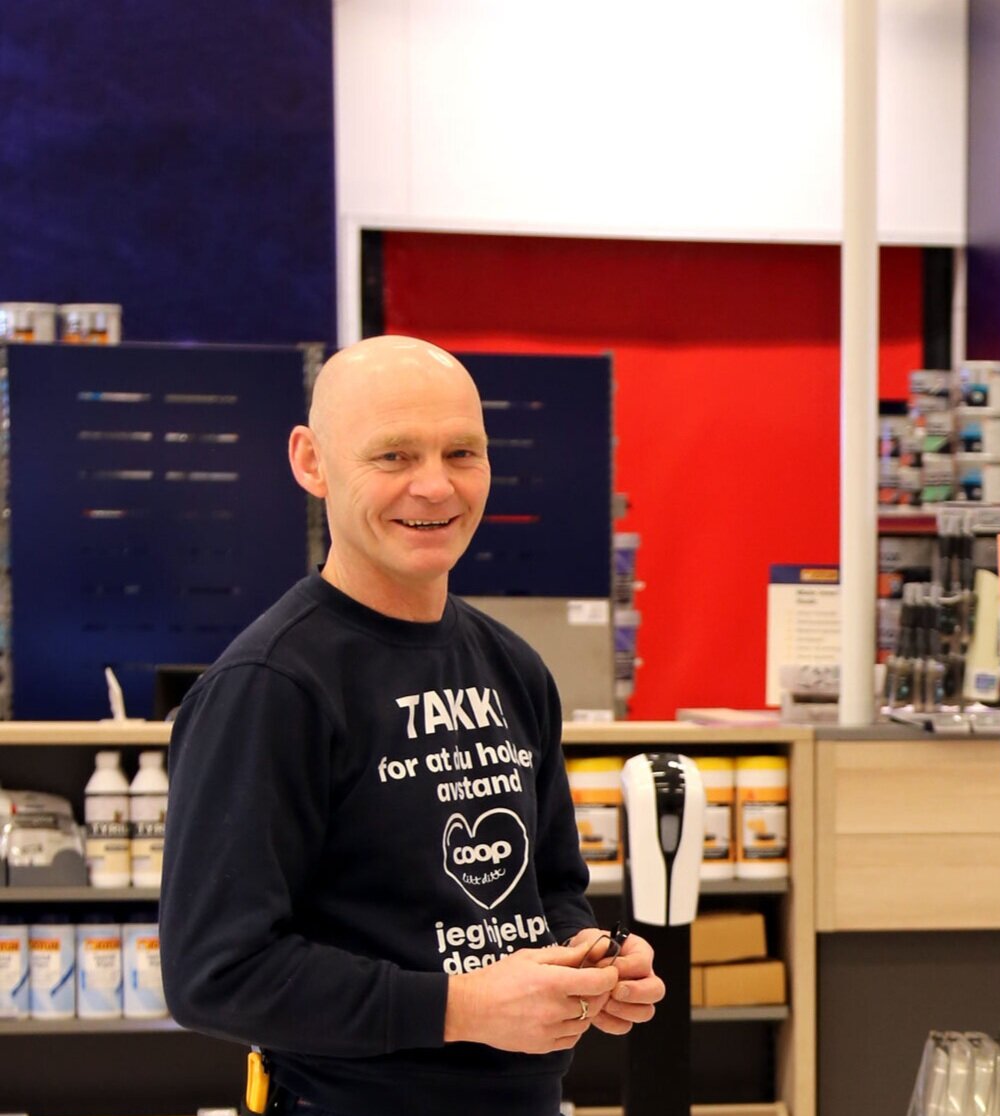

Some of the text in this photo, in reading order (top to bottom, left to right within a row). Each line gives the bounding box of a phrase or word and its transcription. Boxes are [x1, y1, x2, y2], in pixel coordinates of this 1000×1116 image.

[395, 687, 508, 739] TAKK!
[378, 757, 419, 782] for
[426, 748, 452, 773] at
[437, 769, 522, 802] avstand
[453, 841, 512, 865] coop
[435, 921, 484, 953] jeg
